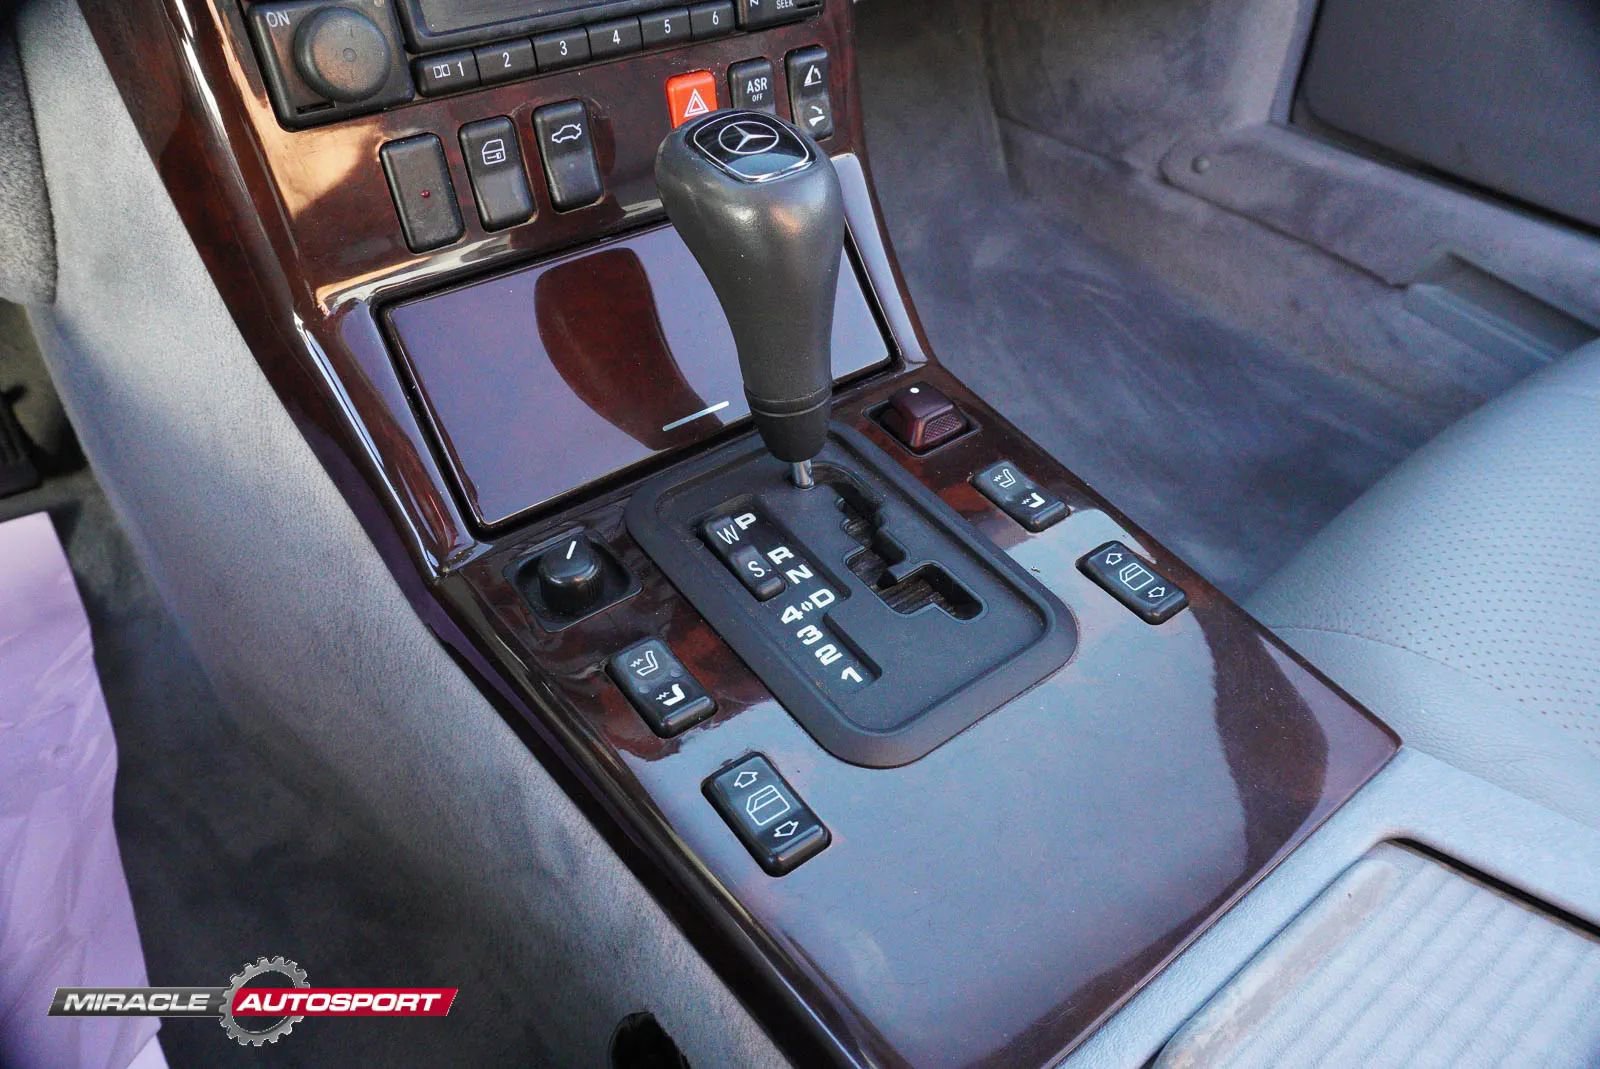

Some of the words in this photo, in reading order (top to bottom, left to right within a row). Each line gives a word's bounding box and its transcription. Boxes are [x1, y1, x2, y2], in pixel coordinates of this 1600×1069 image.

[265, 11, 291, 28] ON
[664, 19, 671, 34] 5
[712, 11, 719, 25] 6
[612, 29, 621, 45] 4
[560, 40, 568, 56] 3
[502, 52, 512, 68] 2
[457, 62, 465, 77] 1
[746, 76, 768, 94] ASR
[752, 93, 763, 102] OFF
[734, 512, 757, 530] P
[716, 524, 740, 544] W
[767, 546, 795, 565] R
[747, 561, 765, 577] S
[785, 564, 814, 584] N
[780, 605, 804, 624] 4
[808, 588, 835, 608] D
[796, 624, 823, 645] 3
[814, 643, 843, 666] 2
[841, 666, 863, 683] 1
